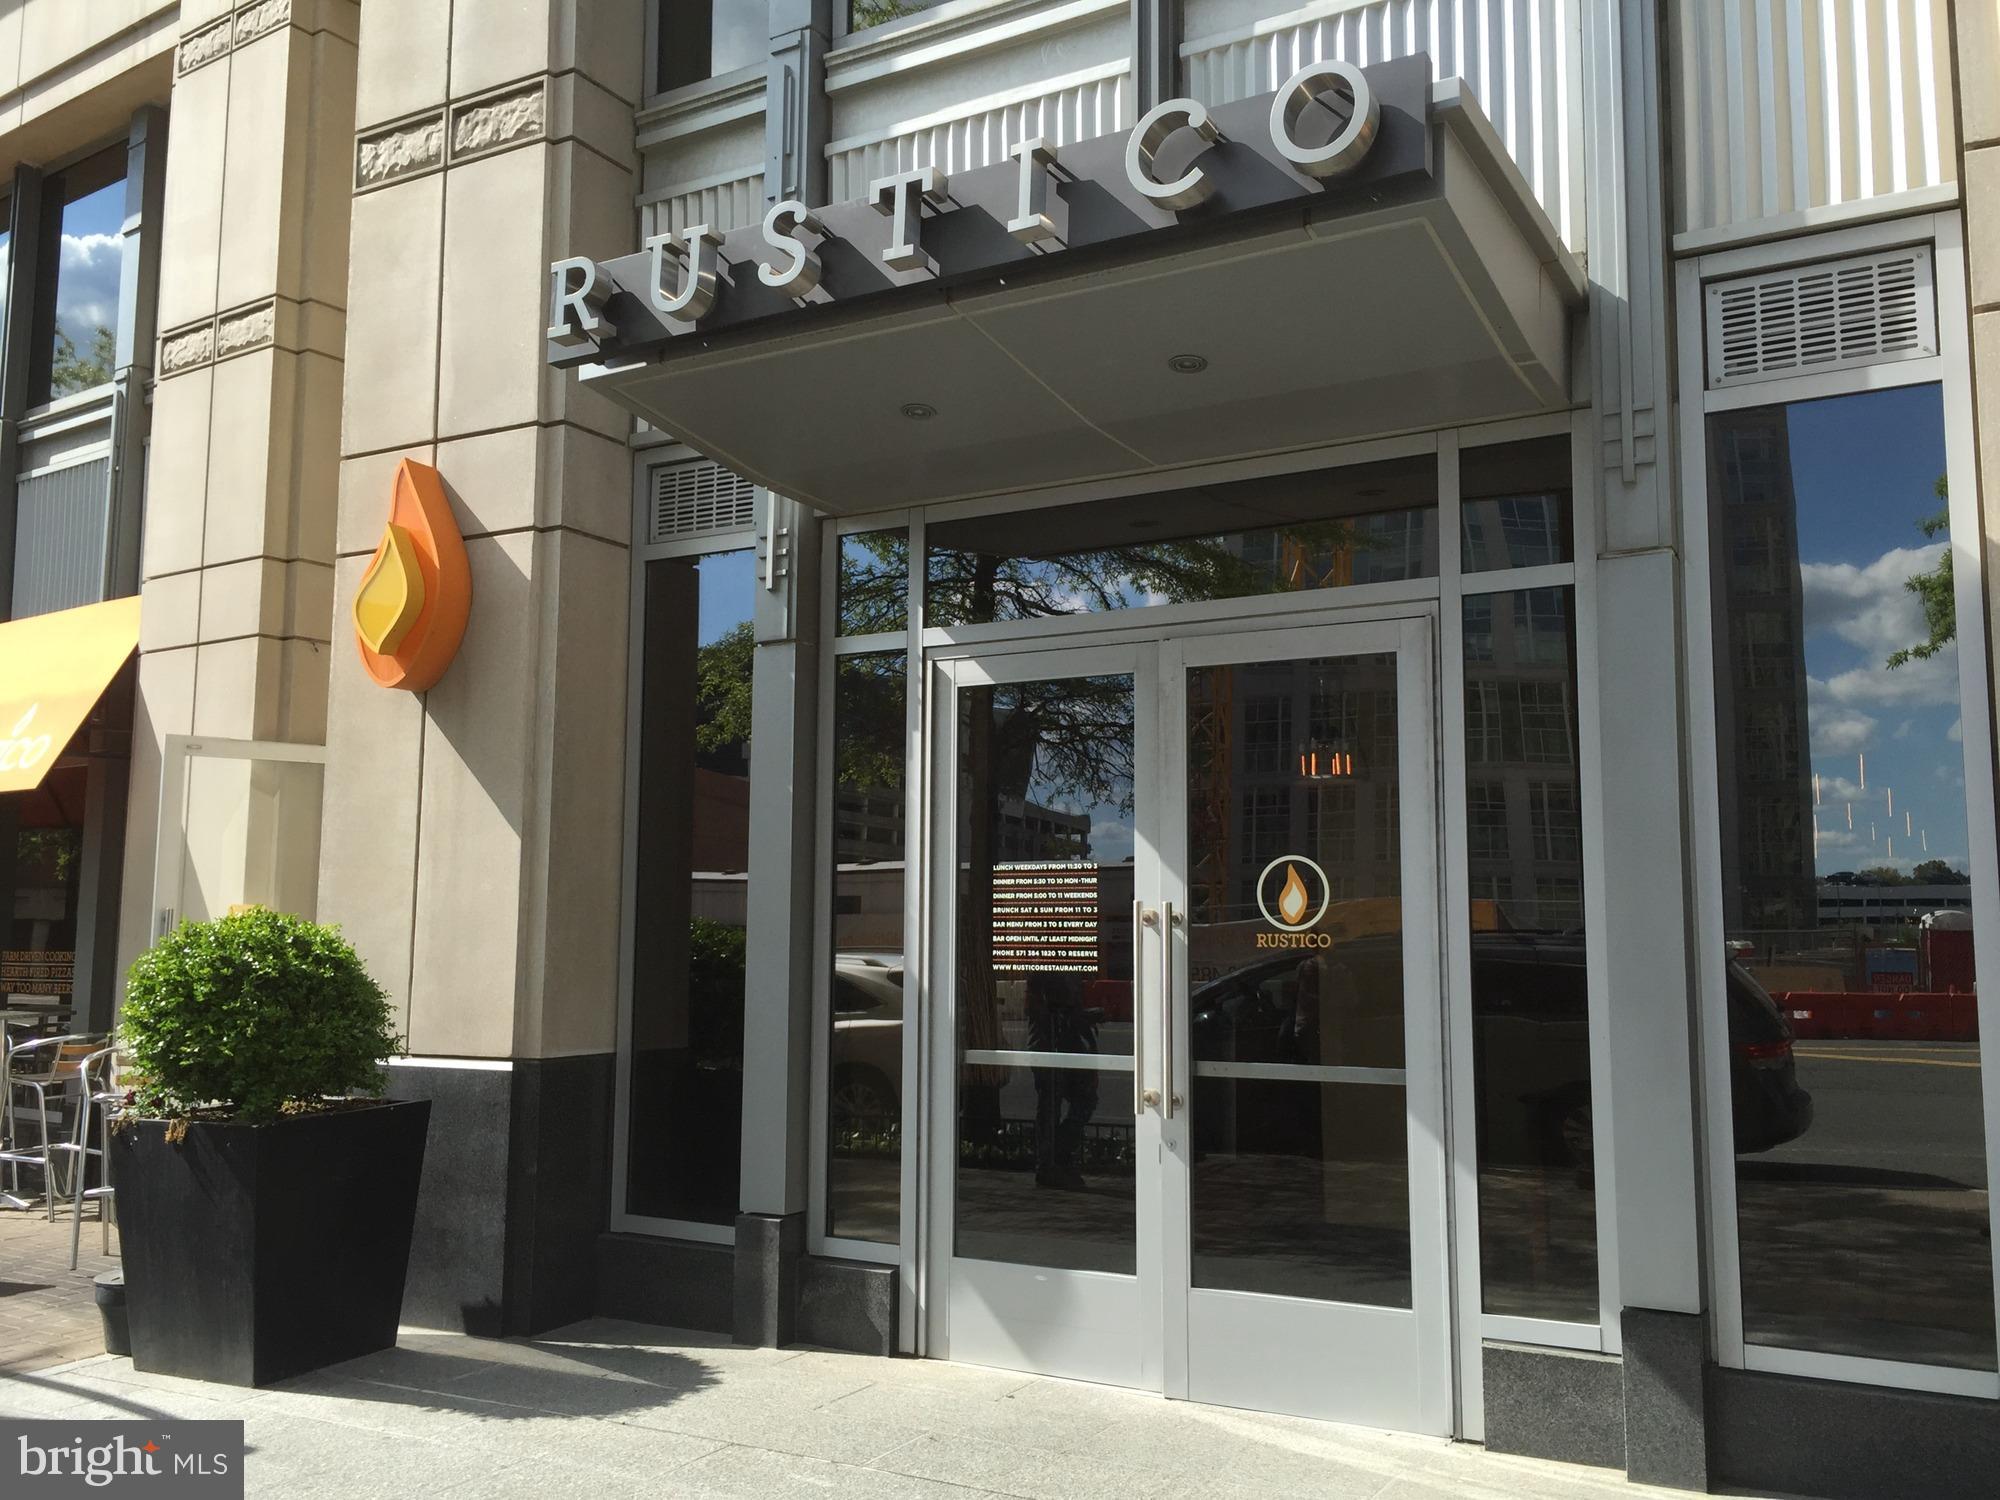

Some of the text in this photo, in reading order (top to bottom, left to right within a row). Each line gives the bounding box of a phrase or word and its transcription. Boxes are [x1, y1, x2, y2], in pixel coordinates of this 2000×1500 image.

[548, 60, 1382, 348] RUSTICO
[1256, 933, 1332, 948] RUSTICO
[0, 982, 15, 993] WAY
[16, 982, 31, 993] TOO
